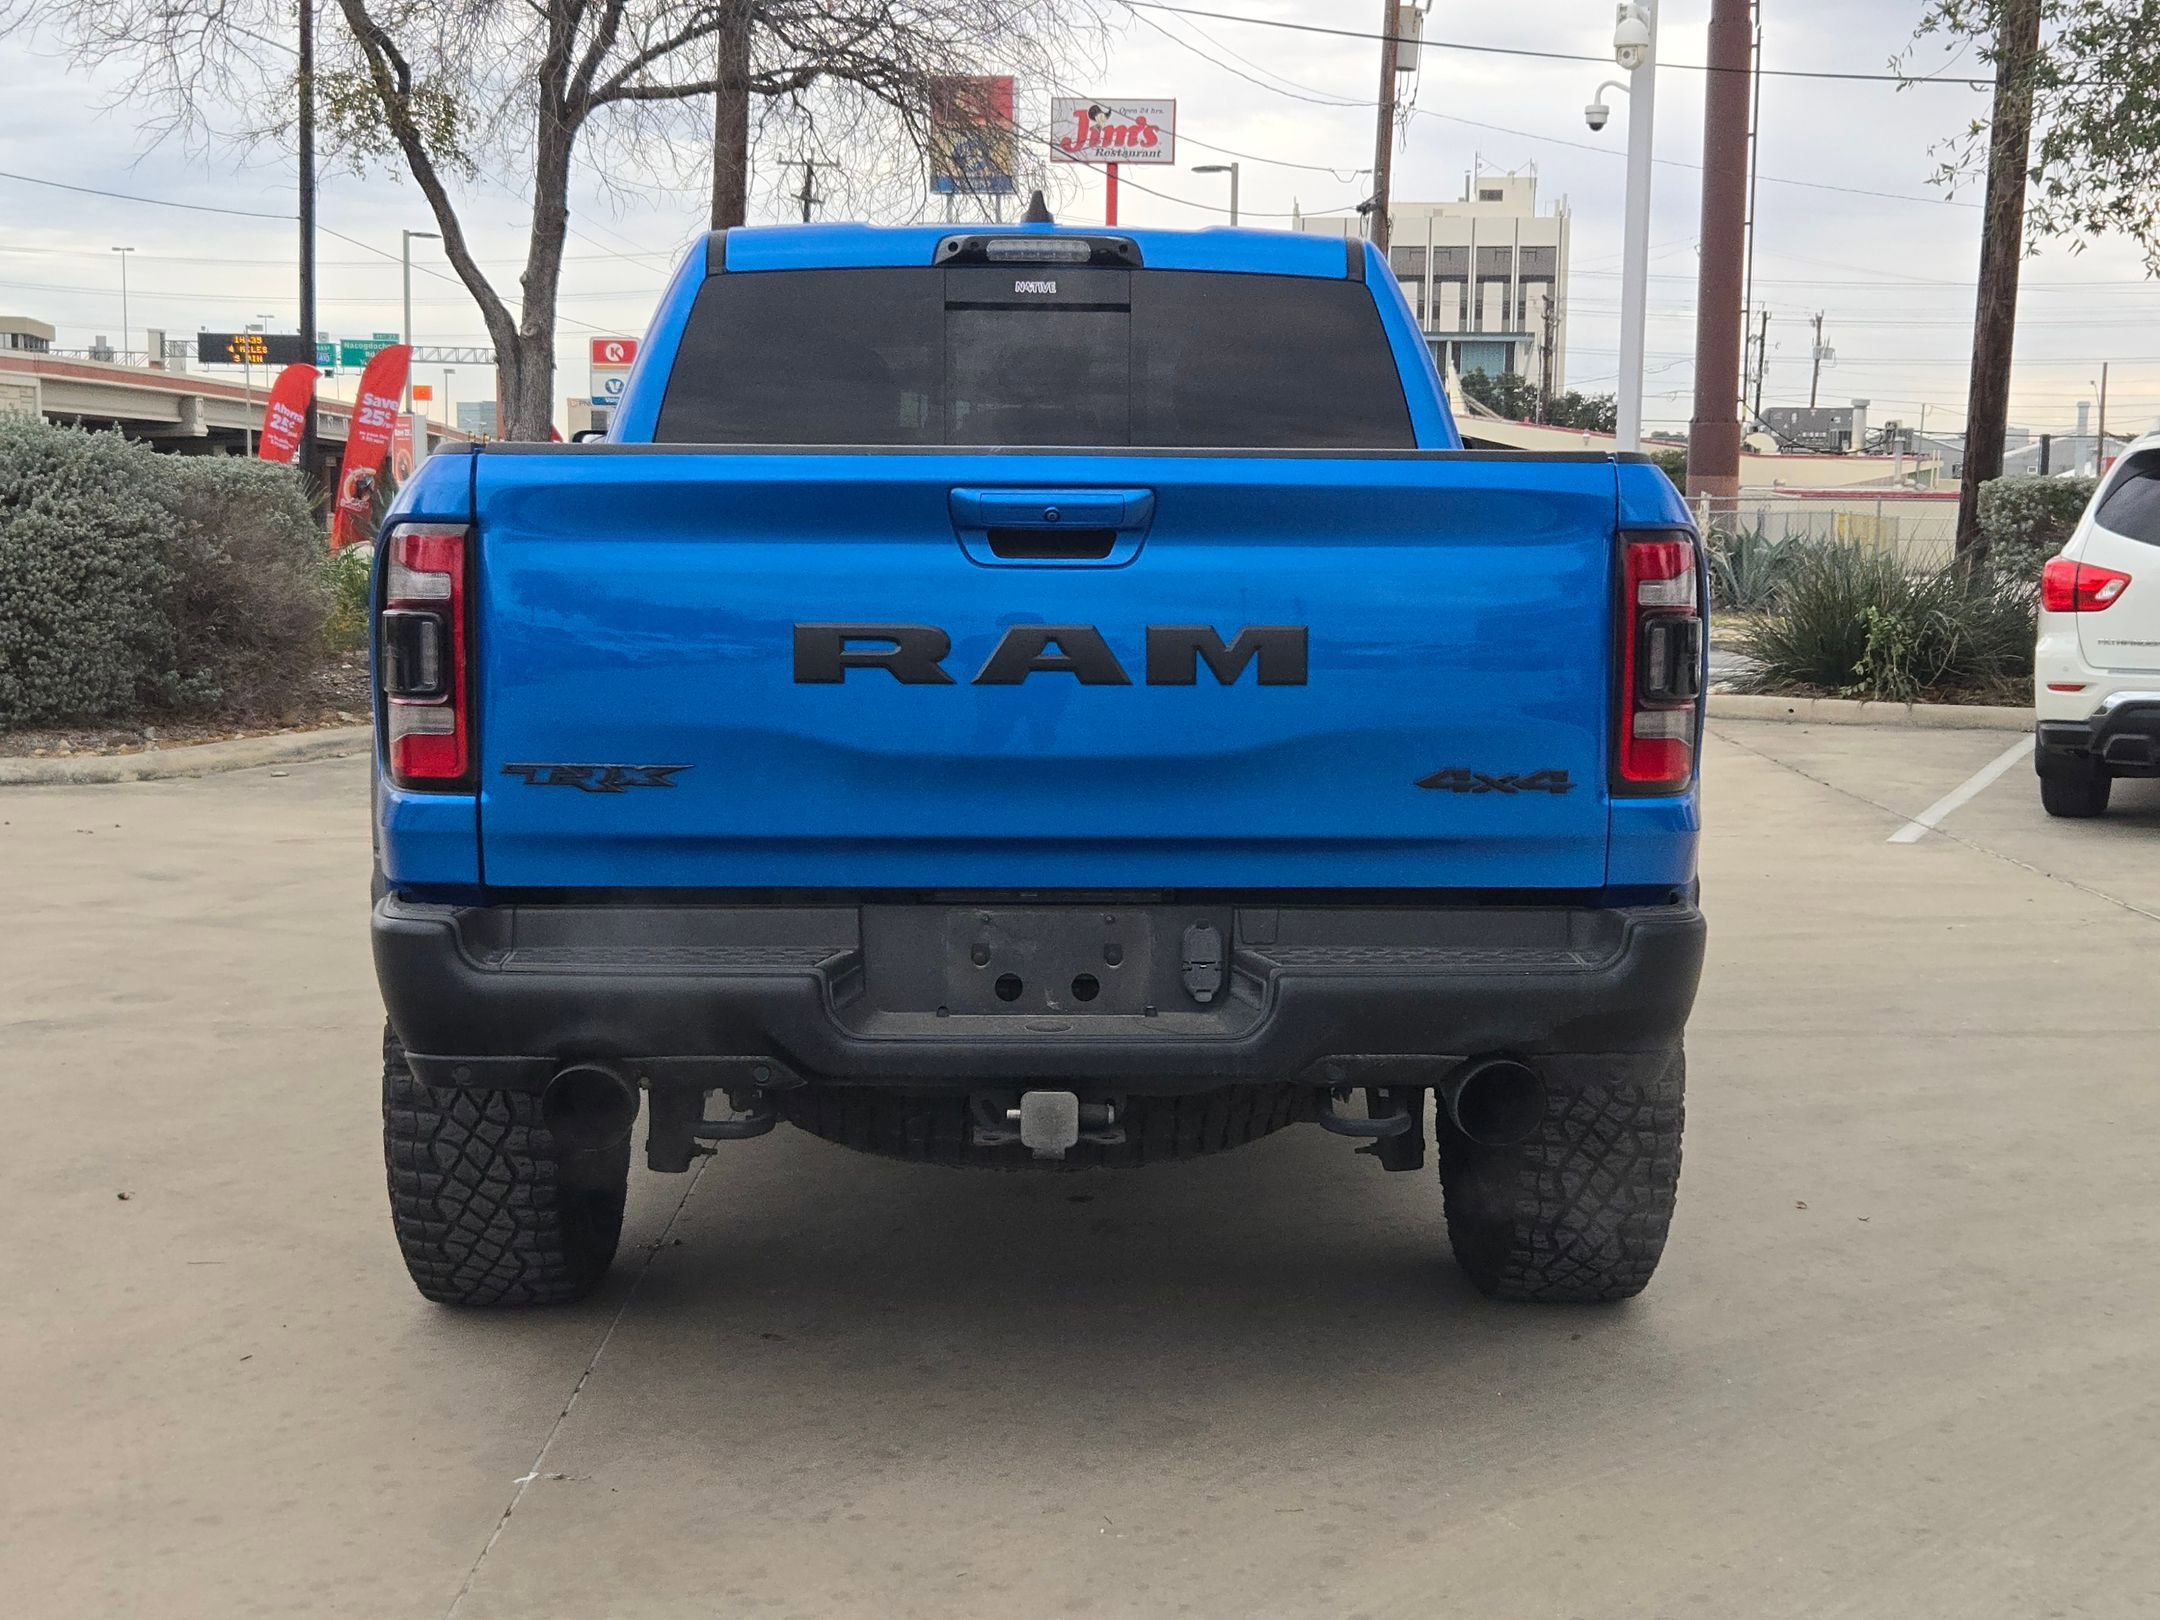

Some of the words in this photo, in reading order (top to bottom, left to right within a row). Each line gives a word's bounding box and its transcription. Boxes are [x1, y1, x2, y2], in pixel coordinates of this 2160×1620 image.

[1061, 108, 1160, 154] Jim's
[1095, 148, 1162, 158] Restaurant
[239, 345, 268, 354] MLES
[343, 341, 386, 351] Nacogdoch
[362, 392, 399, 411] Save
[793, 622, 1308, 686] RAM
[502, 762, 697, 794] TRX
